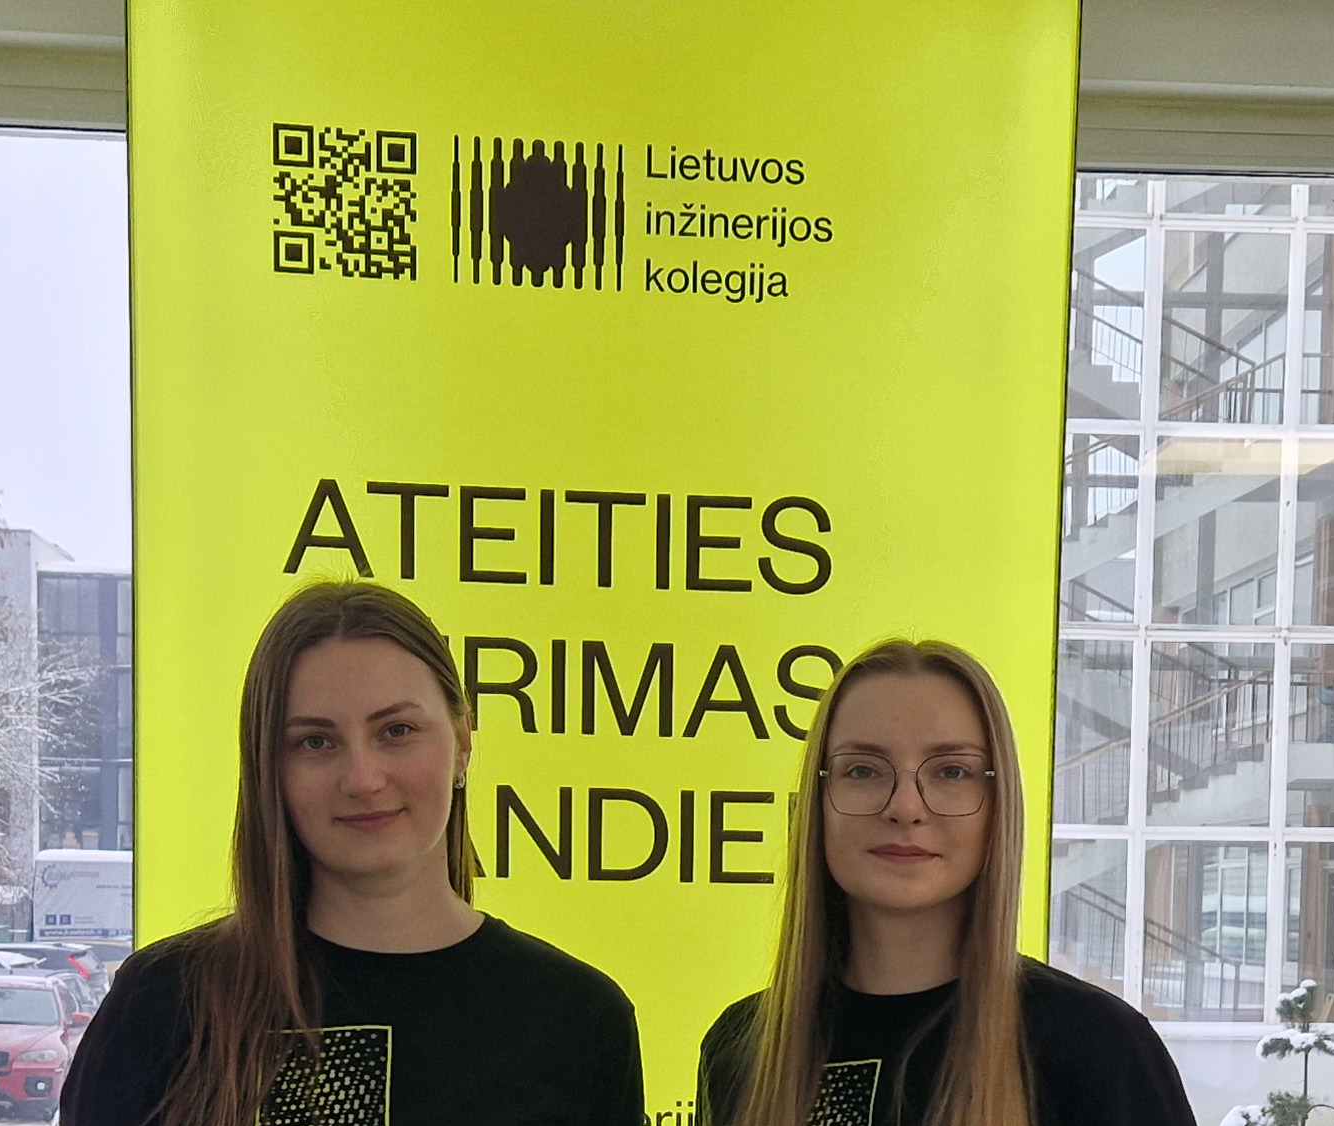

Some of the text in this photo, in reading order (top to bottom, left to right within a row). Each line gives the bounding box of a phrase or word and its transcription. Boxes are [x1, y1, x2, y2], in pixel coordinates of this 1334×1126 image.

[646, 144, 806, 185] Lietuvos
[646, 201, 834, 248] inžinerijos
[645, 258, 789, 304] kolegija
[283, 478, 833, 596] ATEITIES
[441, 635, 844, 743] RIMAS
[473, 784, 799, 885] NDIE
